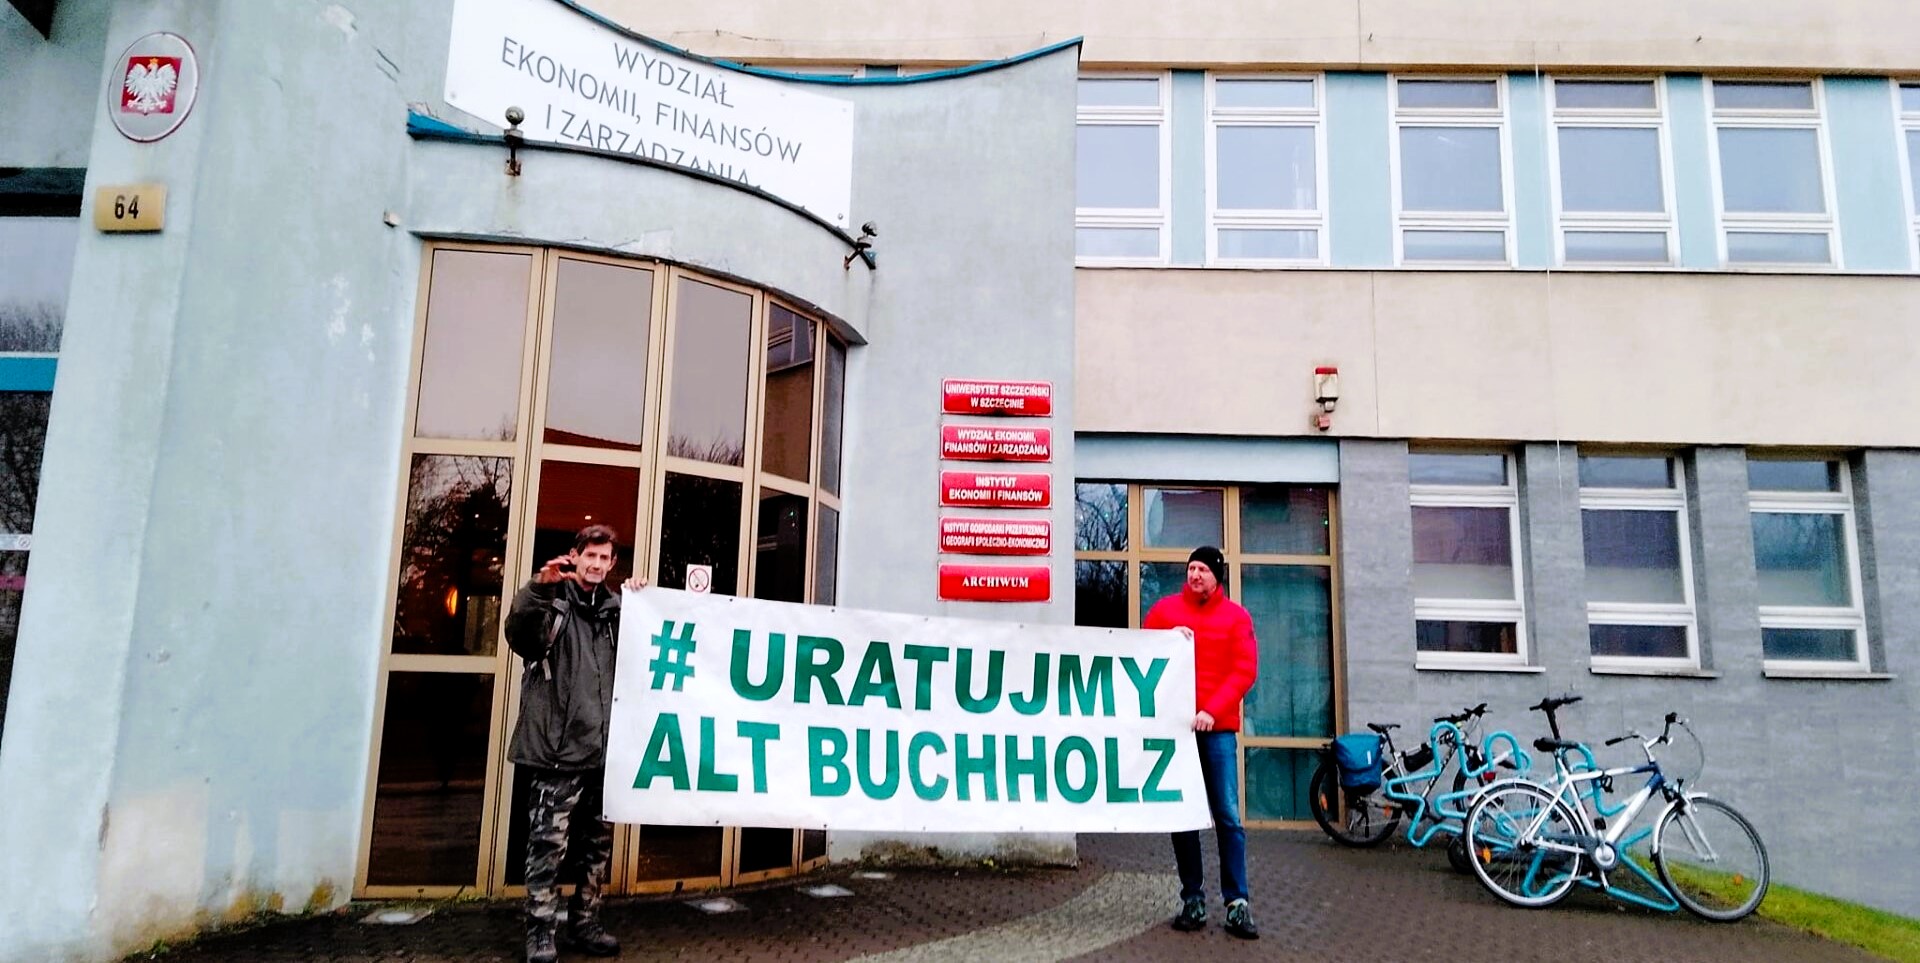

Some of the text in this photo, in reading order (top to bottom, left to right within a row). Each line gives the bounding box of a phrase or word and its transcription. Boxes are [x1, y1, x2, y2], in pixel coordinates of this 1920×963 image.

[614, 42, 734, 109] WYDZIAŁ
[502, 36, 802, 164] EKONOMII, FINANSÓW
[546, 104, 552, 130] I
[114, 195, 139, 219] 64
[945, 383, 1050, 397] UNIWERSYTET SZCZECIŃSKI
[970, 397, 1024, 409] W SZCZECINIE
[957, 429, 1037, 443] WYDZIAŁ EKONOMII,
[944, 441, 1048, 456] FINANSÓW I ZARZĄDZANIA
[975, 477, 1017, 487] INSTYTUT
[949, 489, 1043, 501] EKONOMII I FINANSÓW
[943, 523, 970, 533] INSTYTUT
[962, 576, 1029, 588] ARCHIWUM
[649, 620, 1170, 718] # URATUJMY
[632, 713, 1183, 804] ALT BUCHHOLZ
